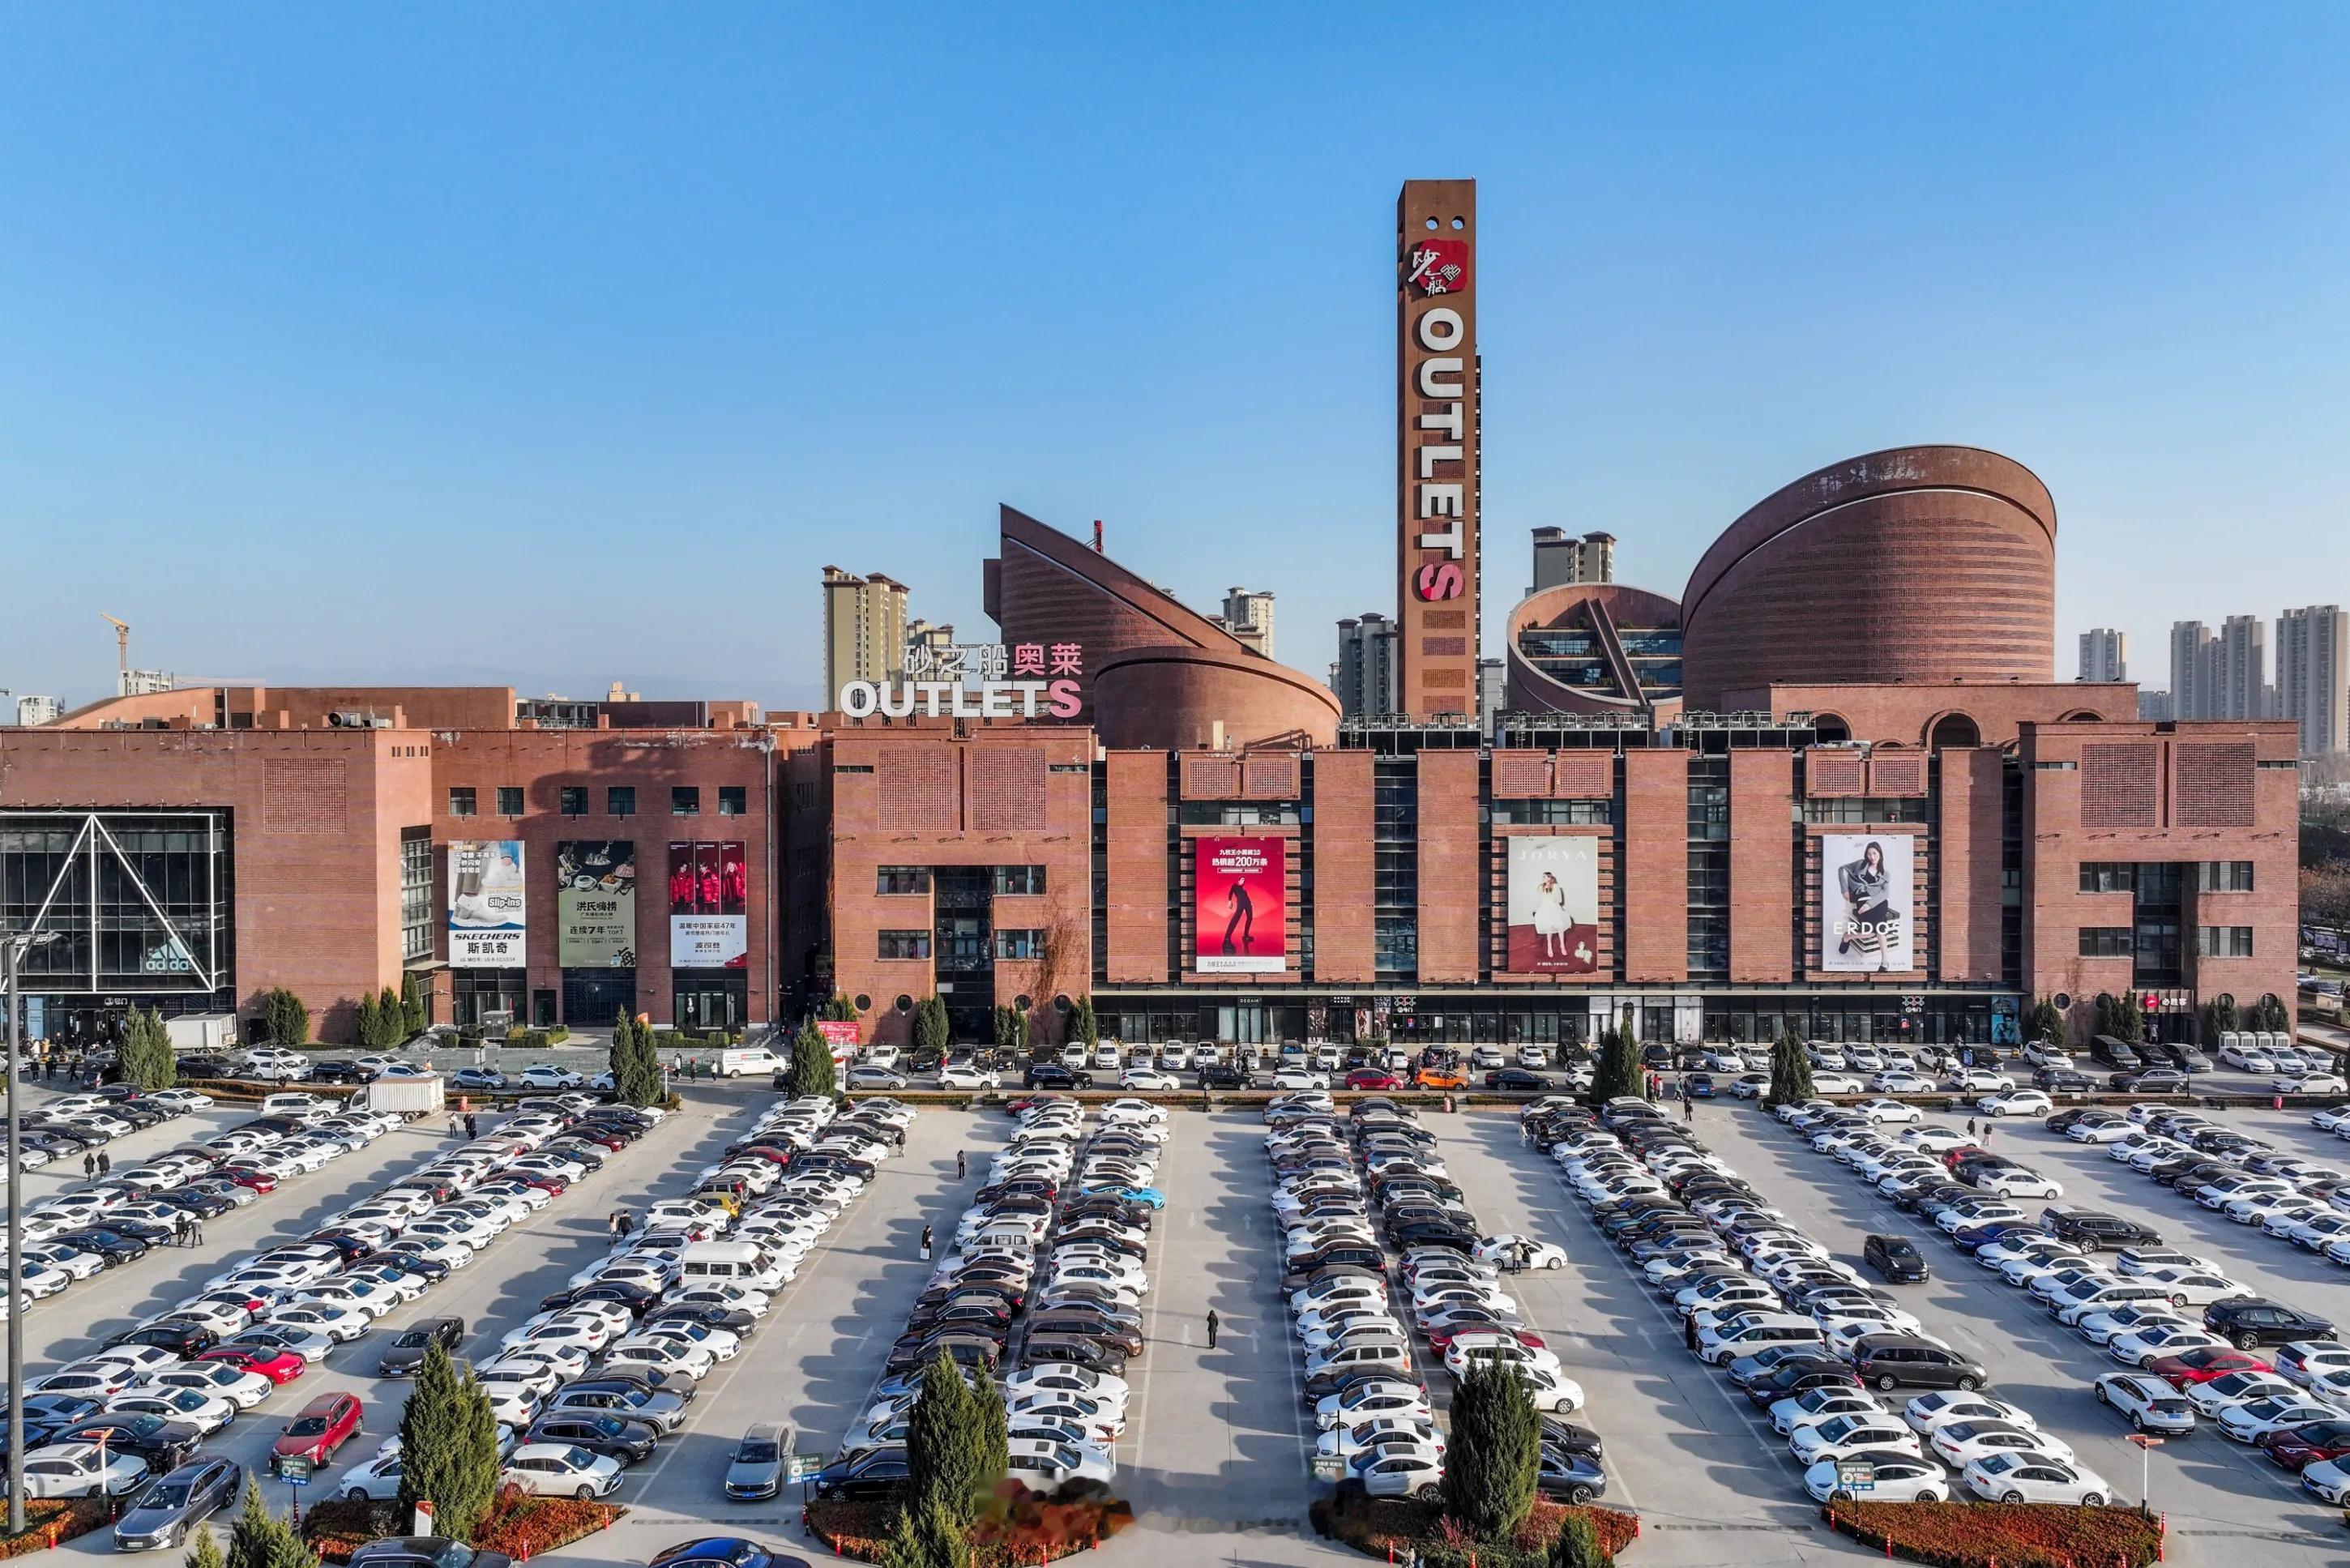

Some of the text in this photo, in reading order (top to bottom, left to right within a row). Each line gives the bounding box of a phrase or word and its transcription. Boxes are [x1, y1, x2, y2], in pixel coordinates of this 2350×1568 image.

[1420, 307, 1464, 601] OUTLETS
[904, 642, 1083, 676] 砂之船奥莱
[840, 679, 1083, 718] OUTLETS
[1518, 849, 1587, 861] JORYA
[488, 896, 522, 908] Slip-ins
[576, 901, 617, 912] 洪氏嗨捞
[570, 925, 605, 934] 连续7年
[1833, 921, 1902, 935] ERDOS
[453, 933, 521, 941] SKECHERS
[468, 942, 508, 954] 斯凯奇
[2162, 998, 2187, 1006] 必胜客
